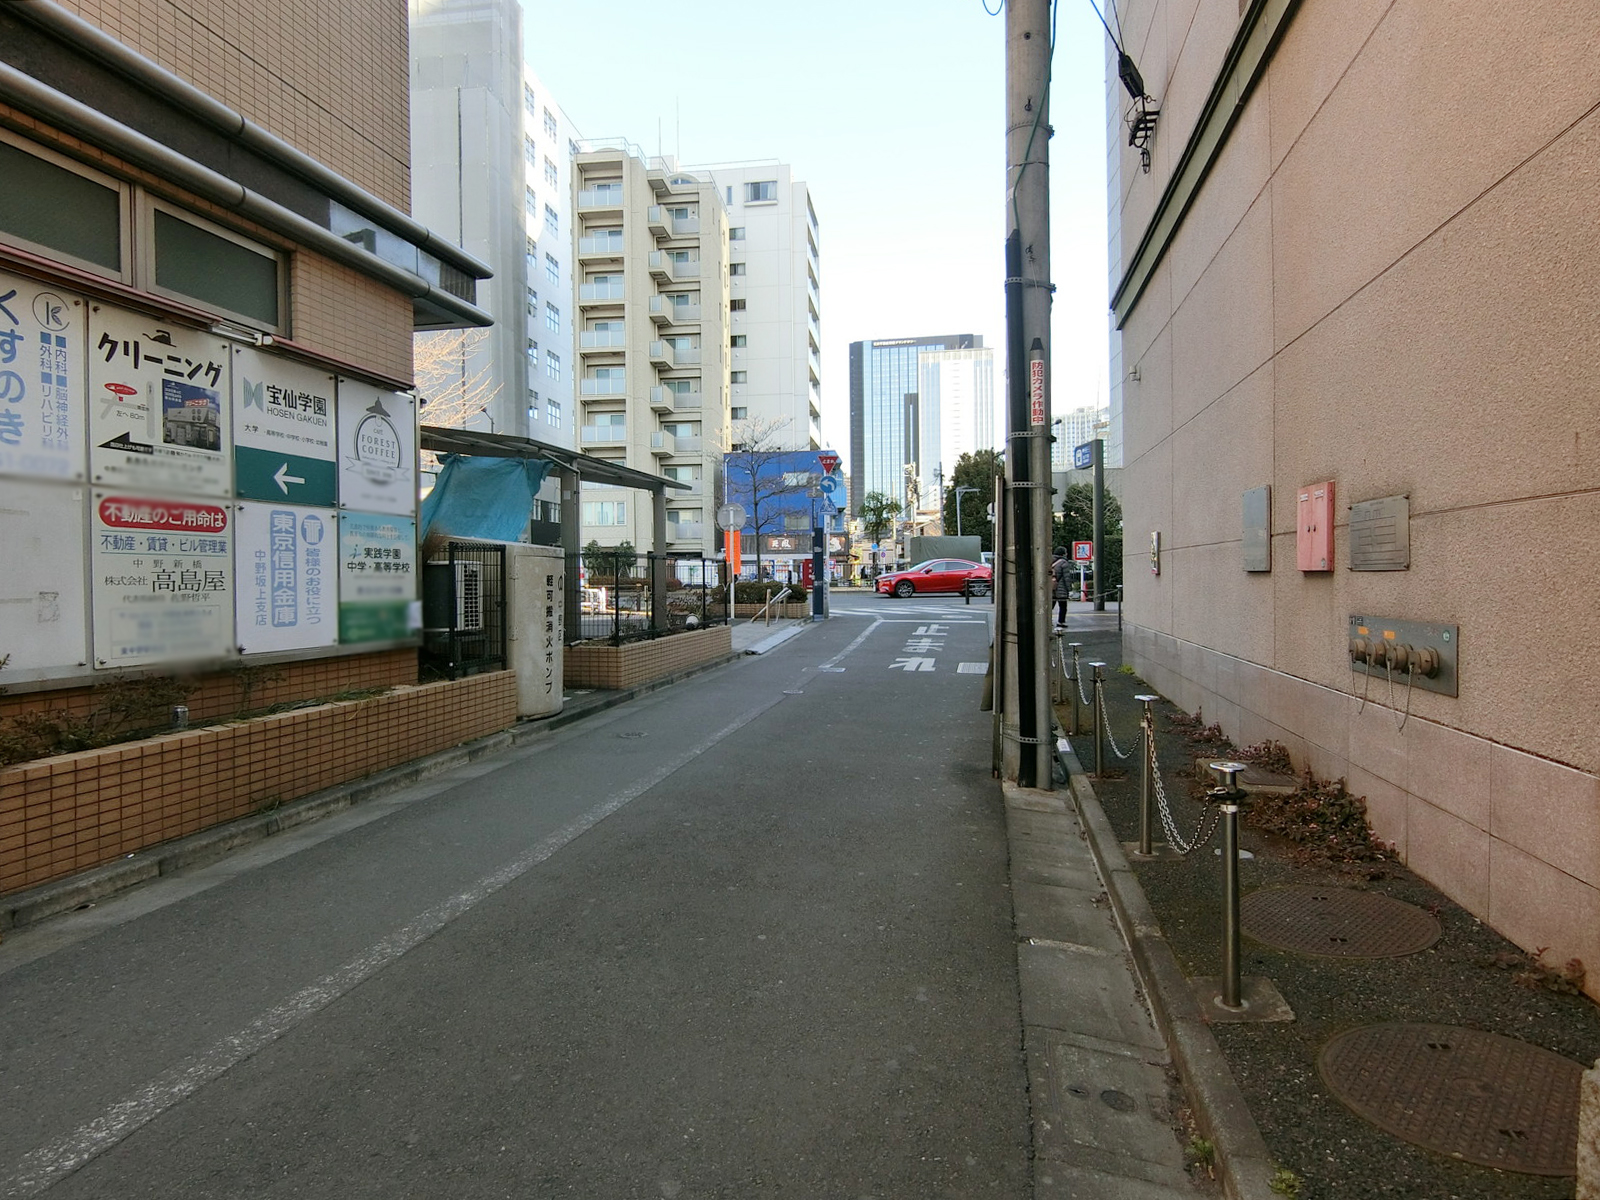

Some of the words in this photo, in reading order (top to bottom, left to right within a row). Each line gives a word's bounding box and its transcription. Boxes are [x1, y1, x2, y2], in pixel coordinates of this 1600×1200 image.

[40, 345, 52, 371] 外科
[55, 348, 67, 374] 内科
[98, 332, 223, 388] クリーニング
[266, 385, 327, 417] 宝仙学園
[1032, 361, 1044, 423] 防犯カメラ作動中
[244, 424, 259, 433] 大学
[267, 406, 295, 420] HOSEN
[296, 413, 327, 427] GAKUEN
[361, 434, 396, 449] FOREST
[362, 445, 396, 459] COFFEE
[104, 503, 224, 527] 不動産のご用命は
[133, 558, 203, 570] 中野新橋
[364, 547, 401, 560] 実践学園
[273, 514, 296, 625] 東京信用金庫
[347, 561, 411, 573] 中学・高等学校
[104, 575, 149, 587] 株式会社
[151, 568, 227, 593] 高島屋
[255, 549, 267, 626] 中野坂上支店
[305, 548, 322, 625] 皆様のお役に立つ
[888, 624, 950, 671] 止まれ
